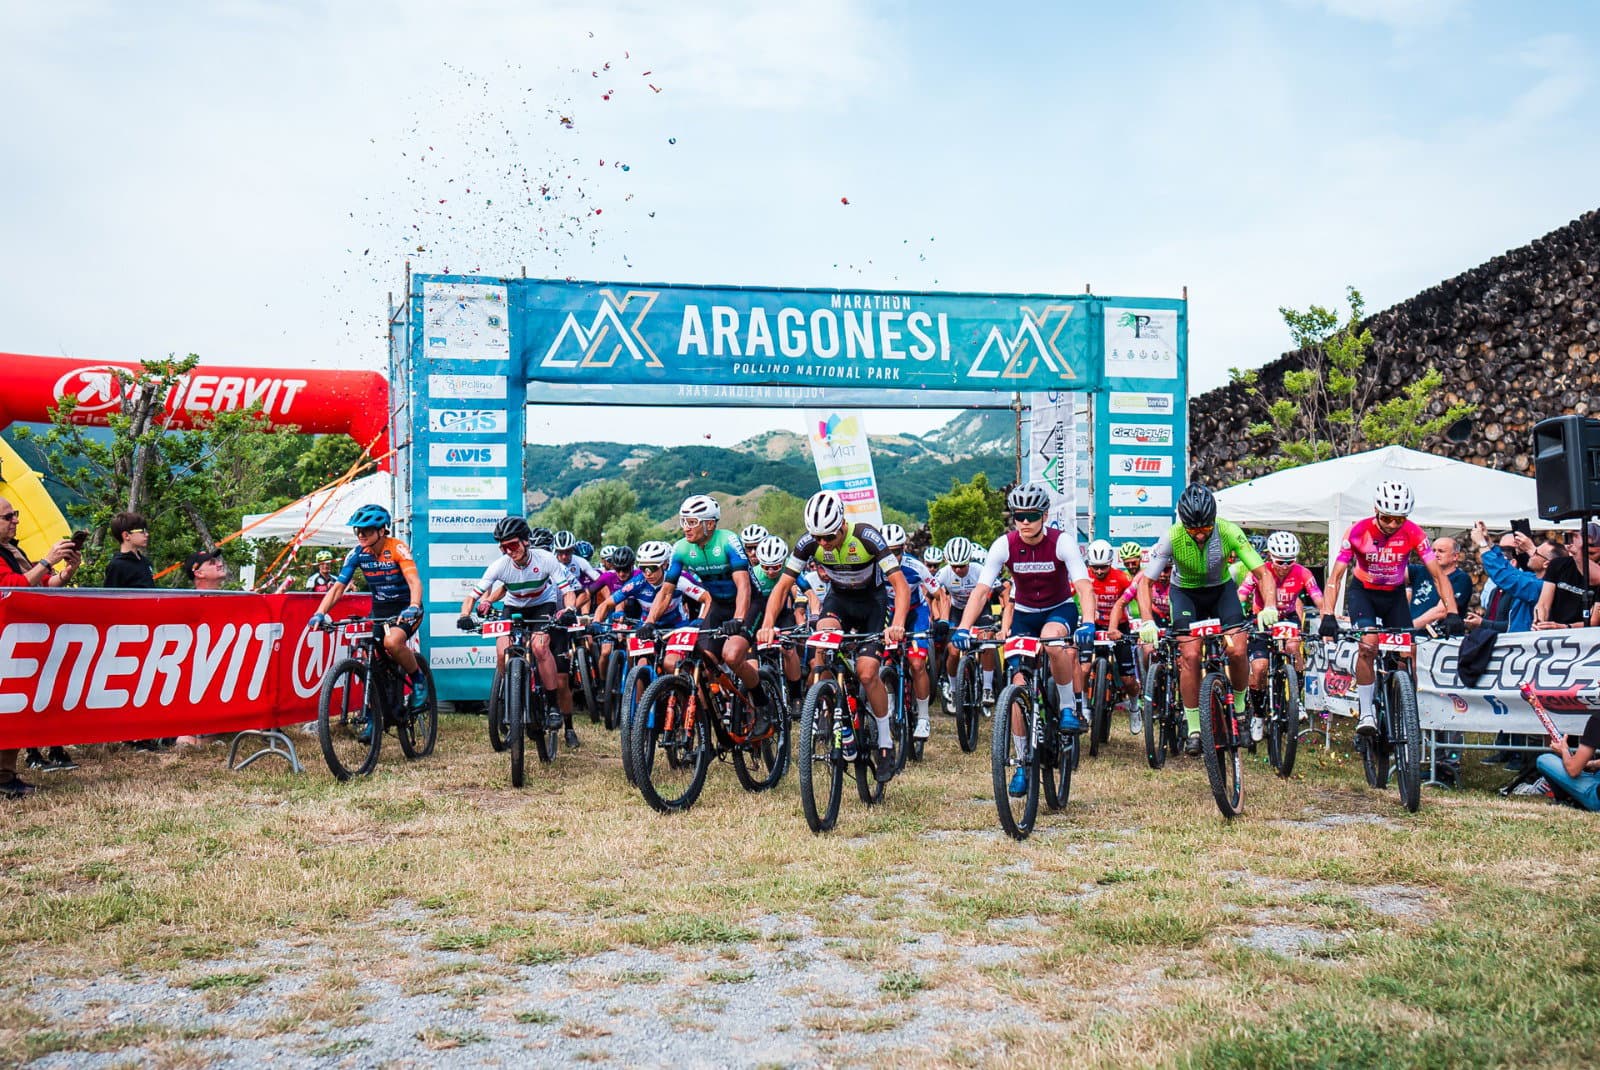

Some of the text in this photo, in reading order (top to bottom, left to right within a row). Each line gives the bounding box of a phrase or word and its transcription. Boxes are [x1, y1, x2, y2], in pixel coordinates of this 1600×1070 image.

[831, 294, 911, 311] MARATHON
[677, 303, 951, 362] ARAGONESI
[733, 362, 901, 381] POLLINO NATIONAL PARK
[128, 372, 308, 415] NERVIT
[445, 448, 492, 463] AVIS
[1056, 420, 1065, 495] ARAGONESI
[489, 624, 504, 634] 10
[1279, 627, 1293, 638] 24
[675, 632, 690, 645] 14
[819, 632, 830, 642] 5
[1014, 639, 1025, 650] 4
[1385, 633, 1404, 645] 26
[0, 622, 284, 715] ENERVIT
